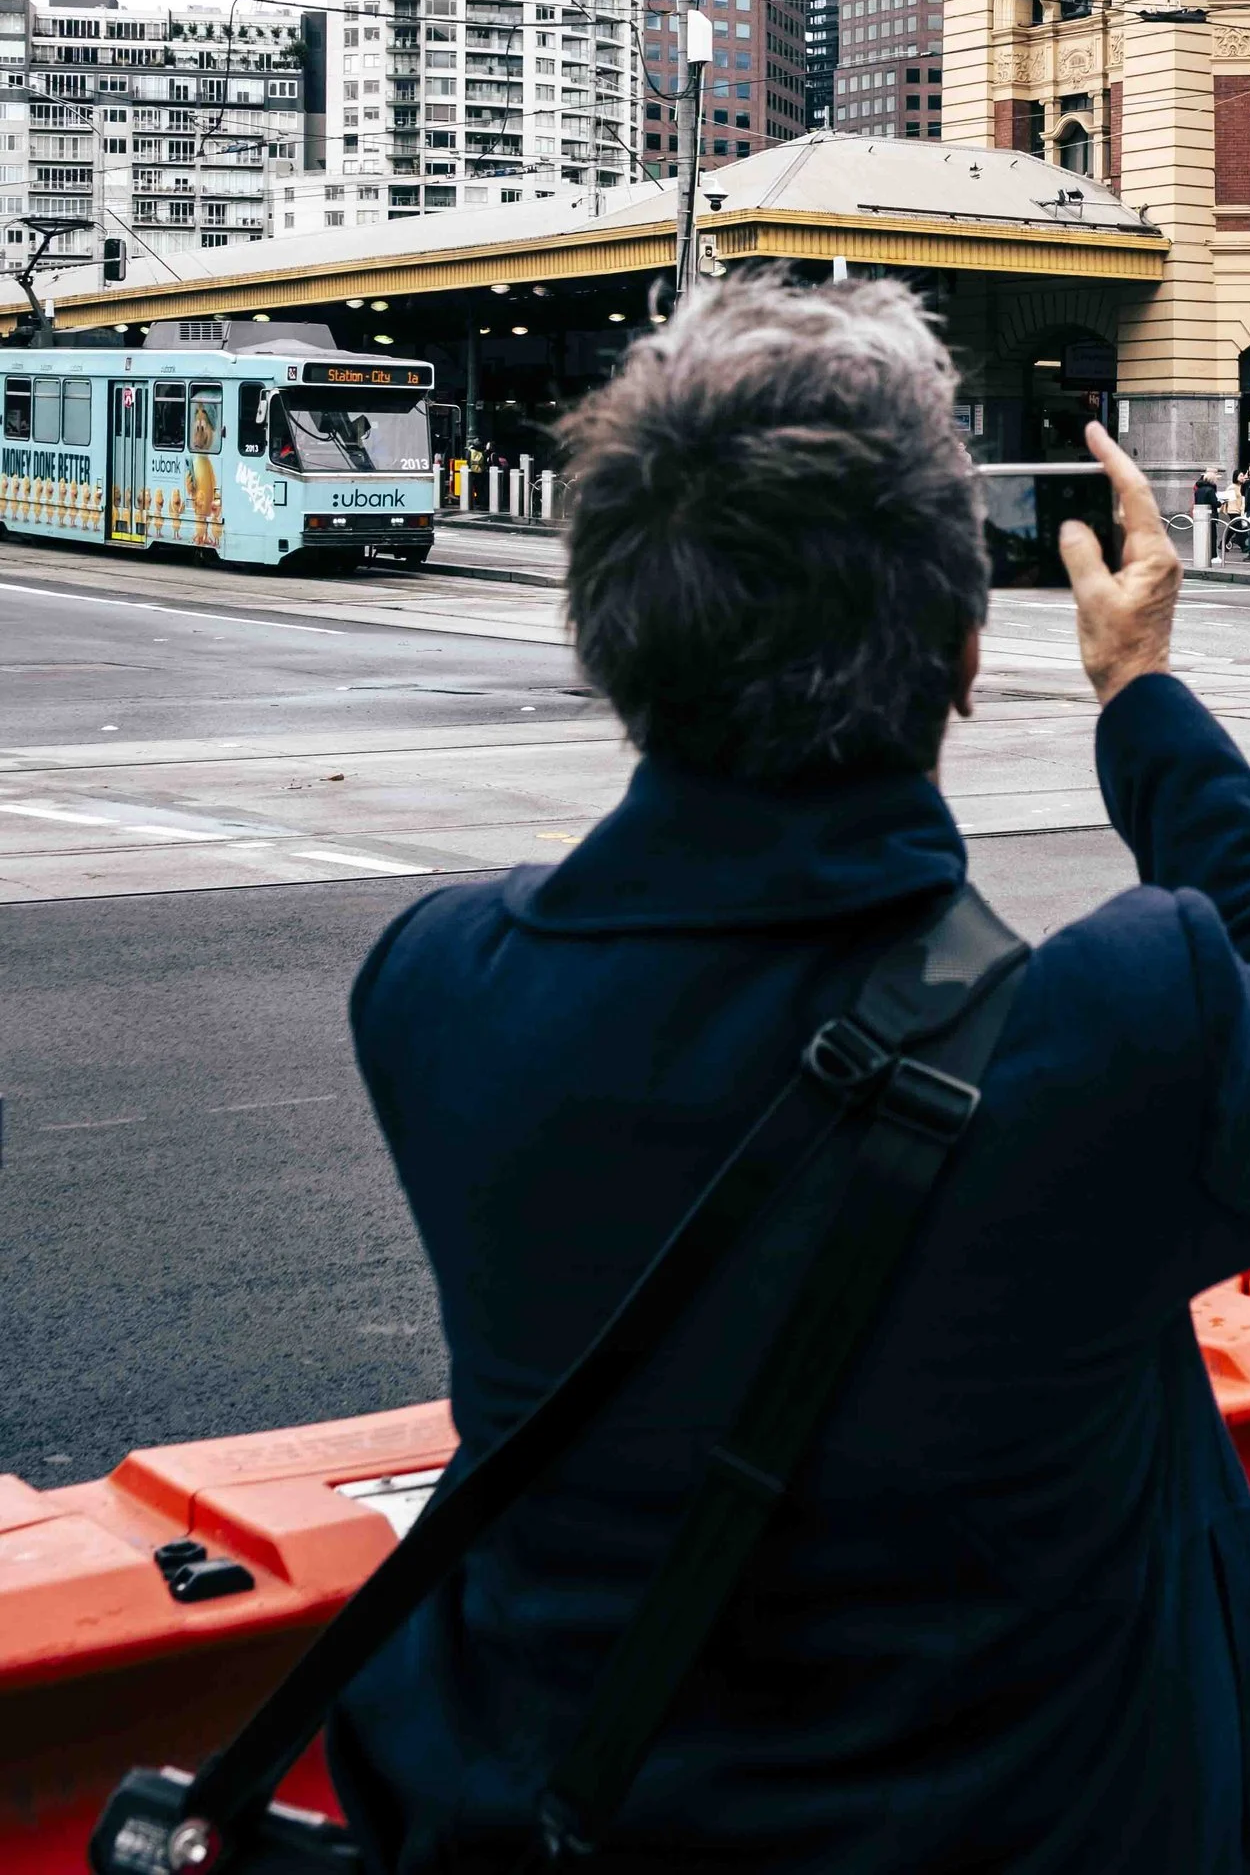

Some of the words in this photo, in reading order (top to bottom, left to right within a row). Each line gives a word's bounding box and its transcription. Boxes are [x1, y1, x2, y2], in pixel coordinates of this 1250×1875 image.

[328, 369, 363, 382] Station
[371, 371, 390, 383] City
[407, 372, 419, 384] 1a
[245, 444, 259, 453] 2013
[2, 448, 32, 478] MONEY
[33, 451, 56, 482] DONE
[58, 453, 91, 485] BETTER
[400, 458, 430, 470] 2013
